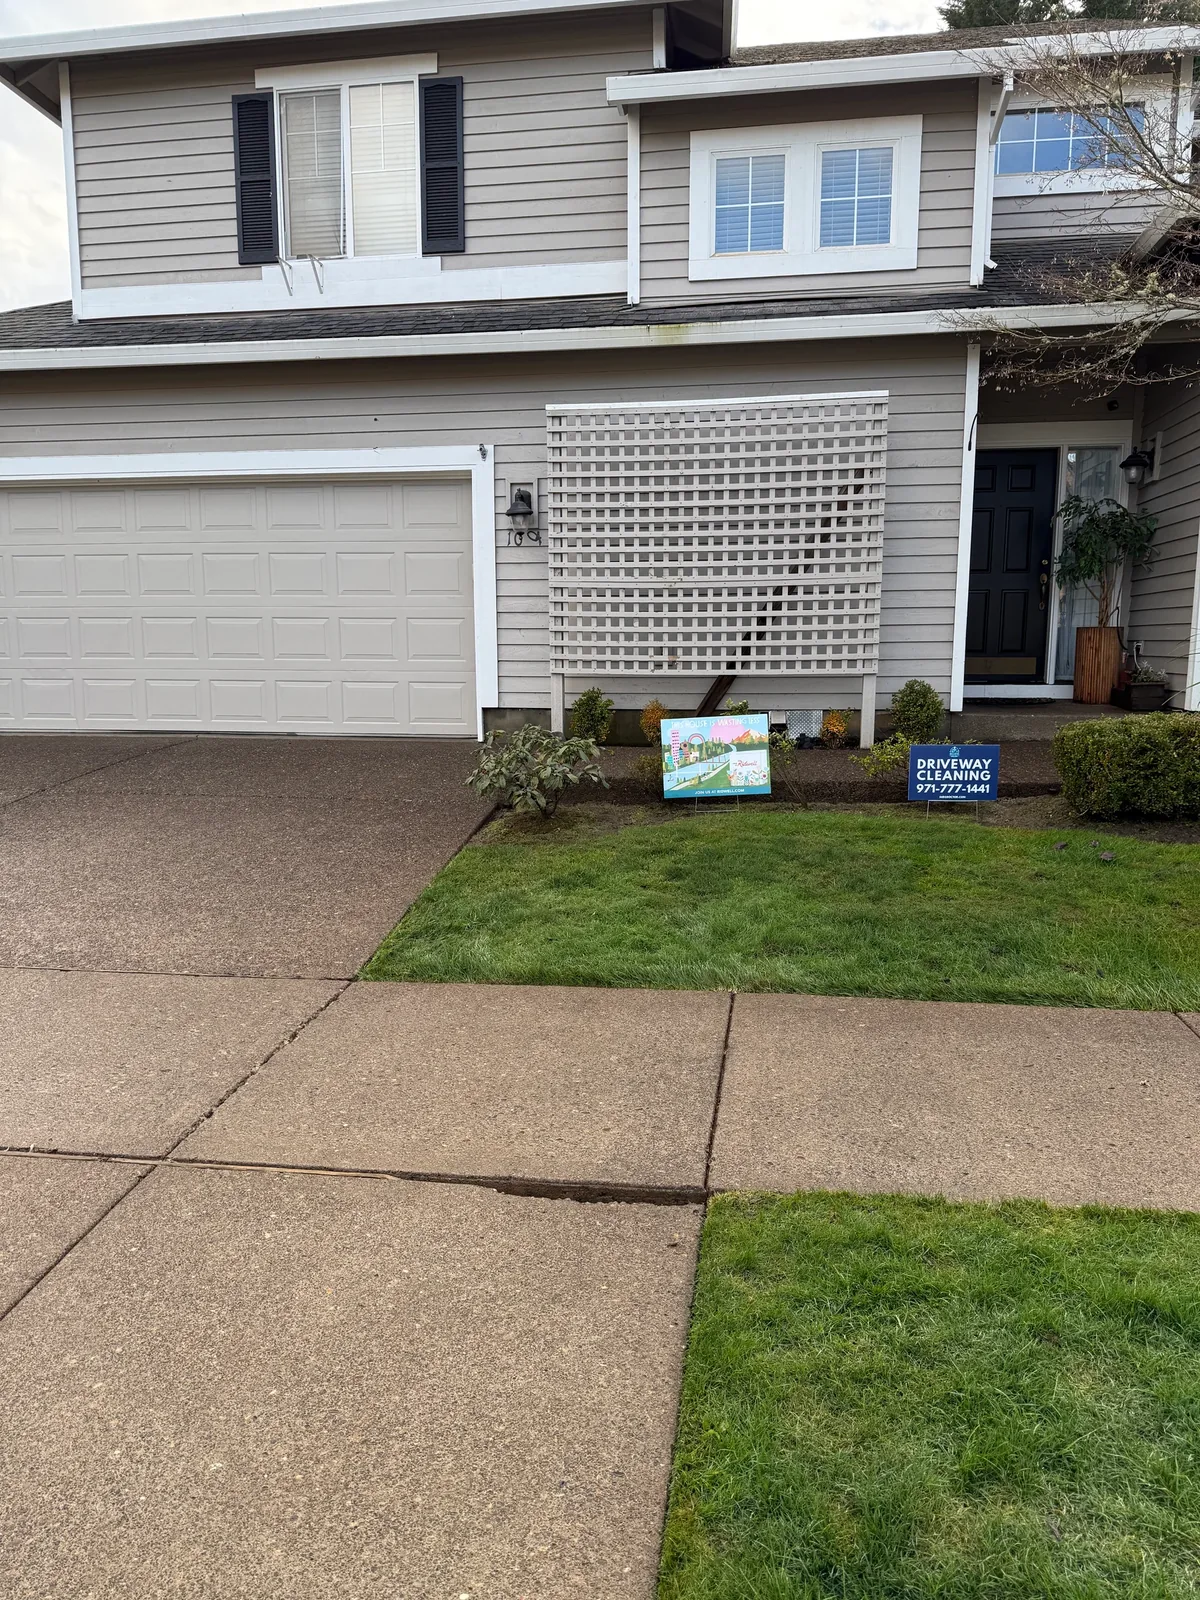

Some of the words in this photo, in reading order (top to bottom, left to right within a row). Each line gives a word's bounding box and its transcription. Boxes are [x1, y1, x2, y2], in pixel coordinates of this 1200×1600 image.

[671, 721, 684, 729] THIS
[684, 720, 708, 728] HOUSE
[709, 719, 715, 727] IS
[717, 718, 747, 726] WASTING
[748, 717, 760, 725] LESS
[737, 759, 758, 767] Ridwell
[917, 758, 992, 770] DRIVEWAY
[916, 770, 991, 781] CLEANING
[916, 783, 990, 793] 971-777-1441
